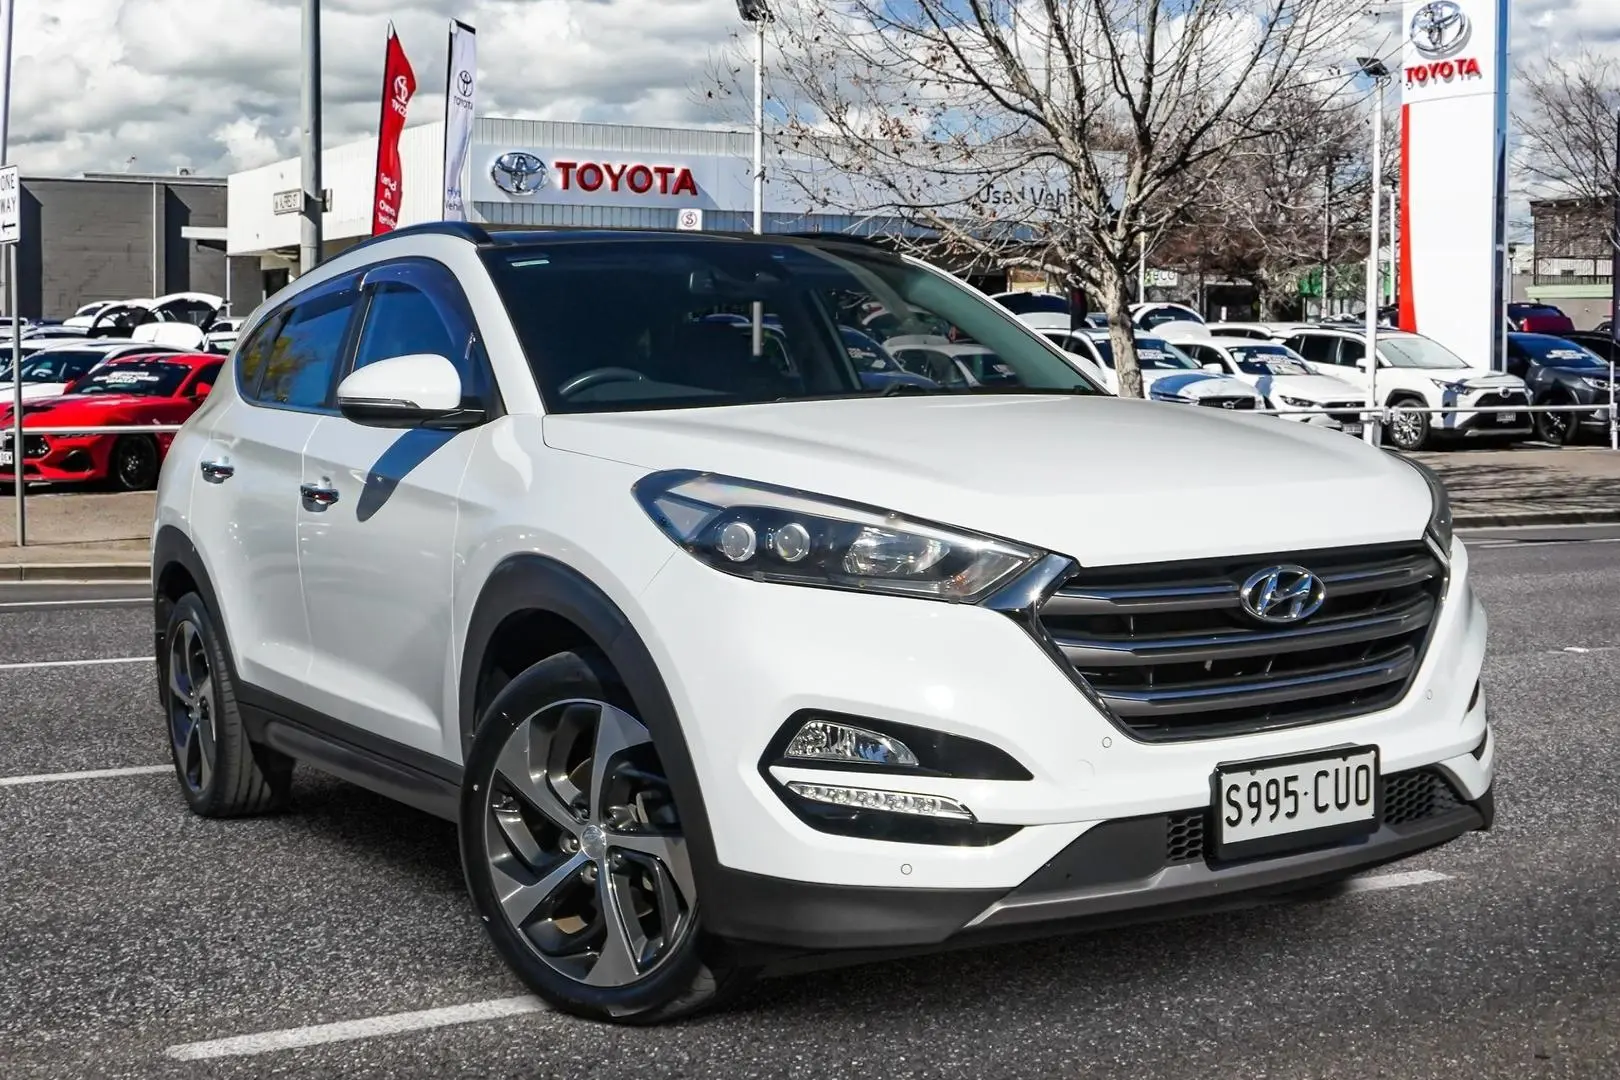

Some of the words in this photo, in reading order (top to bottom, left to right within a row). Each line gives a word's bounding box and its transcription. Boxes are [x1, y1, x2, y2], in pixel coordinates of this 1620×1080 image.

[1404, 58, 1481, 83] TOYOTA
[0, 173, 15, 191] ONE
[555, 162, 698, 196] TOYOTA
[0, 196, 16, 214] WAY
